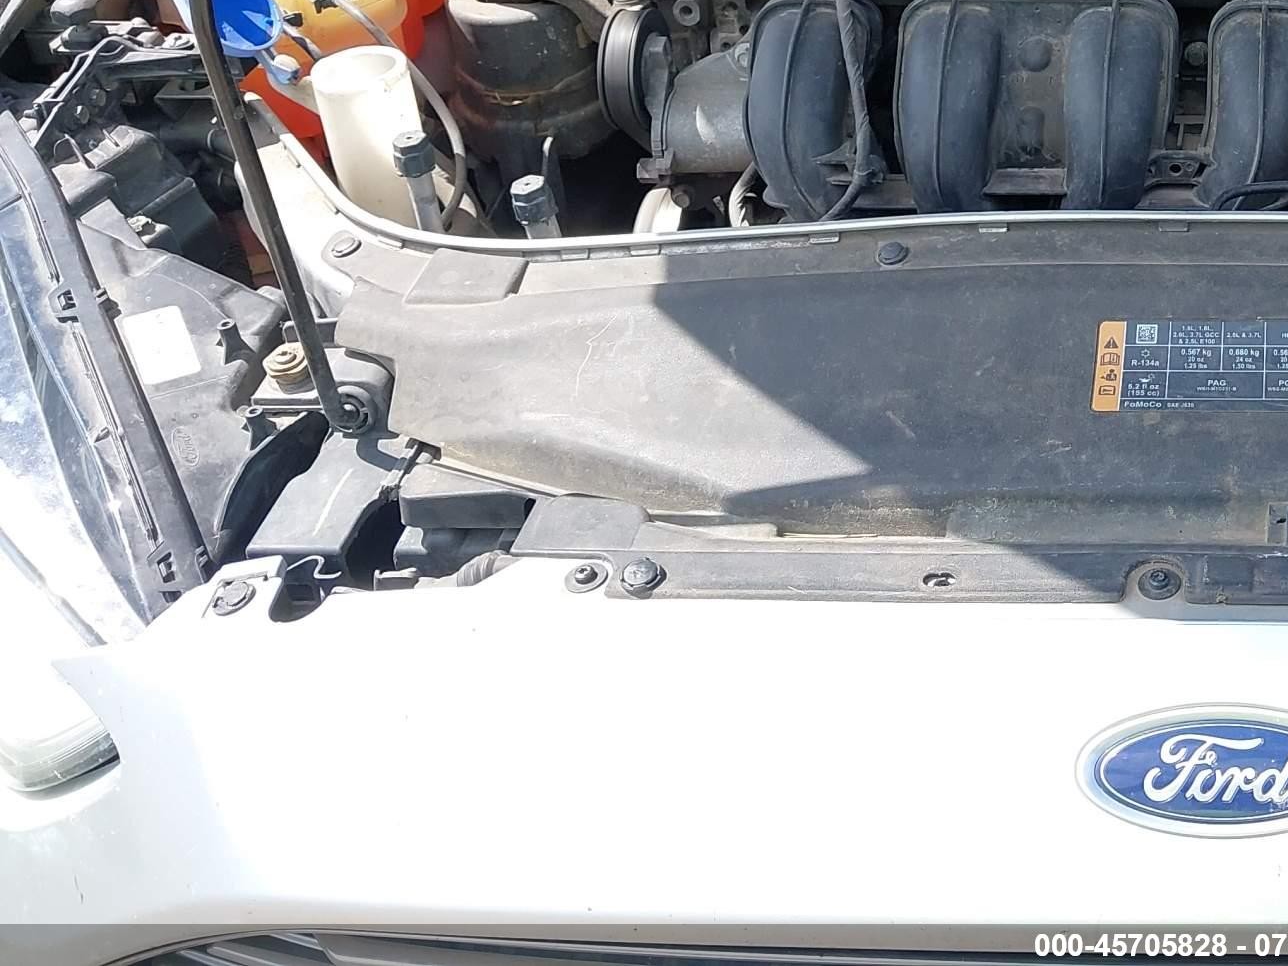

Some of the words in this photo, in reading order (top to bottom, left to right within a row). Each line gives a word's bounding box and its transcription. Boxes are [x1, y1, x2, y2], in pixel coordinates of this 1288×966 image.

[1202, 348, 1212, 357] kg
[1250, 348, 1260, 357] kg
[1131, 359, 1160, 367] R-134a
[1147, 389, 1160, 397] cc)
